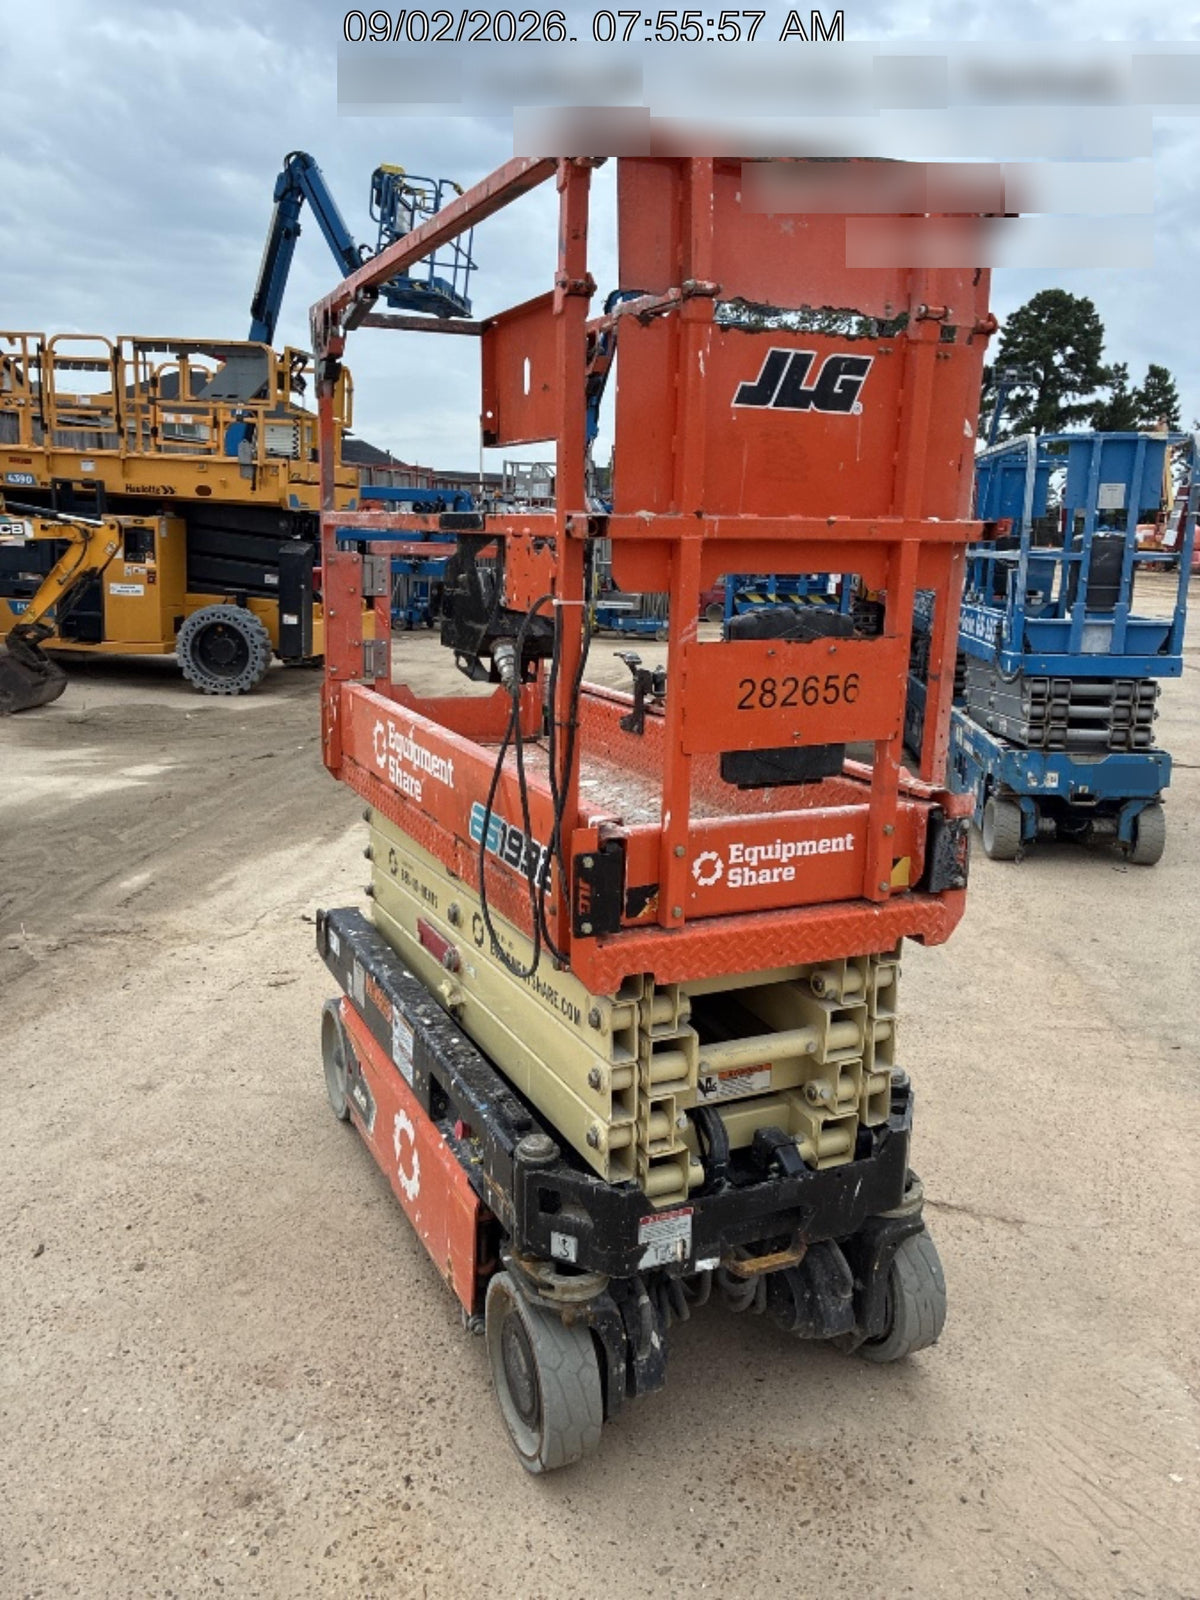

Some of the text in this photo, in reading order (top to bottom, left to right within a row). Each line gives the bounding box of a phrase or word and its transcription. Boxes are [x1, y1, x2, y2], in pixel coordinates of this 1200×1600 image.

[737, 673, 859, 710] 282656
[387, 719, 454, 788] Equipment
[388, 755, 422, 802] Share
[728, 833, 855, 866] Equipment
[727, 866, 796, 888] Share
